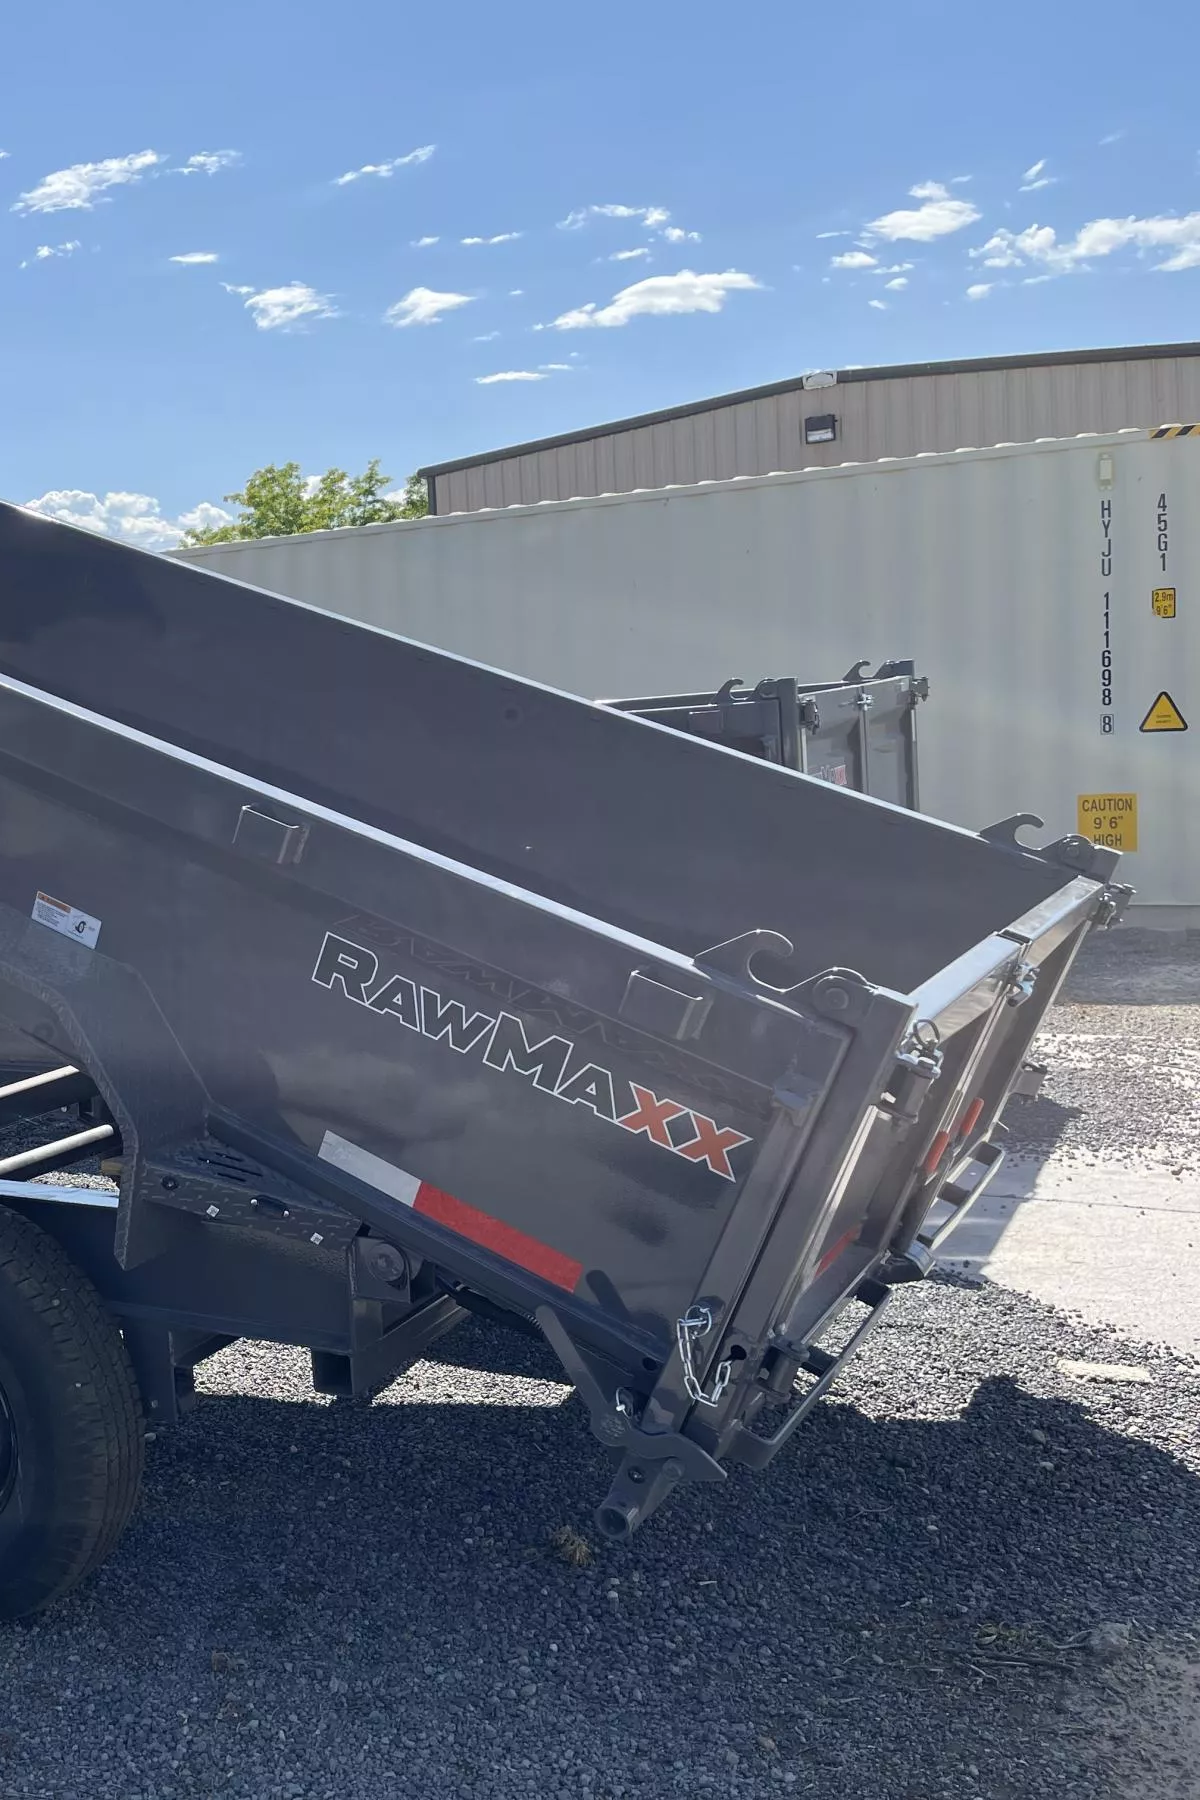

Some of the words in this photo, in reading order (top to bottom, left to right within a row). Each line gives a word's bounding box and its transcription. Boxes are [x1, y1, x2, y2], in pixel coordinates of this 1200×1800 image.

[1101, 499, 1112, 577] HYJU
[1157, 493, 1168, 572] 45G1
[1101, 591, 1112, 706] 111698
[1102, 715, 1112, 733] 8
[1082, 798, 1133, 812] CAUTION
[1093, 833, 1122, 847] HIGH
